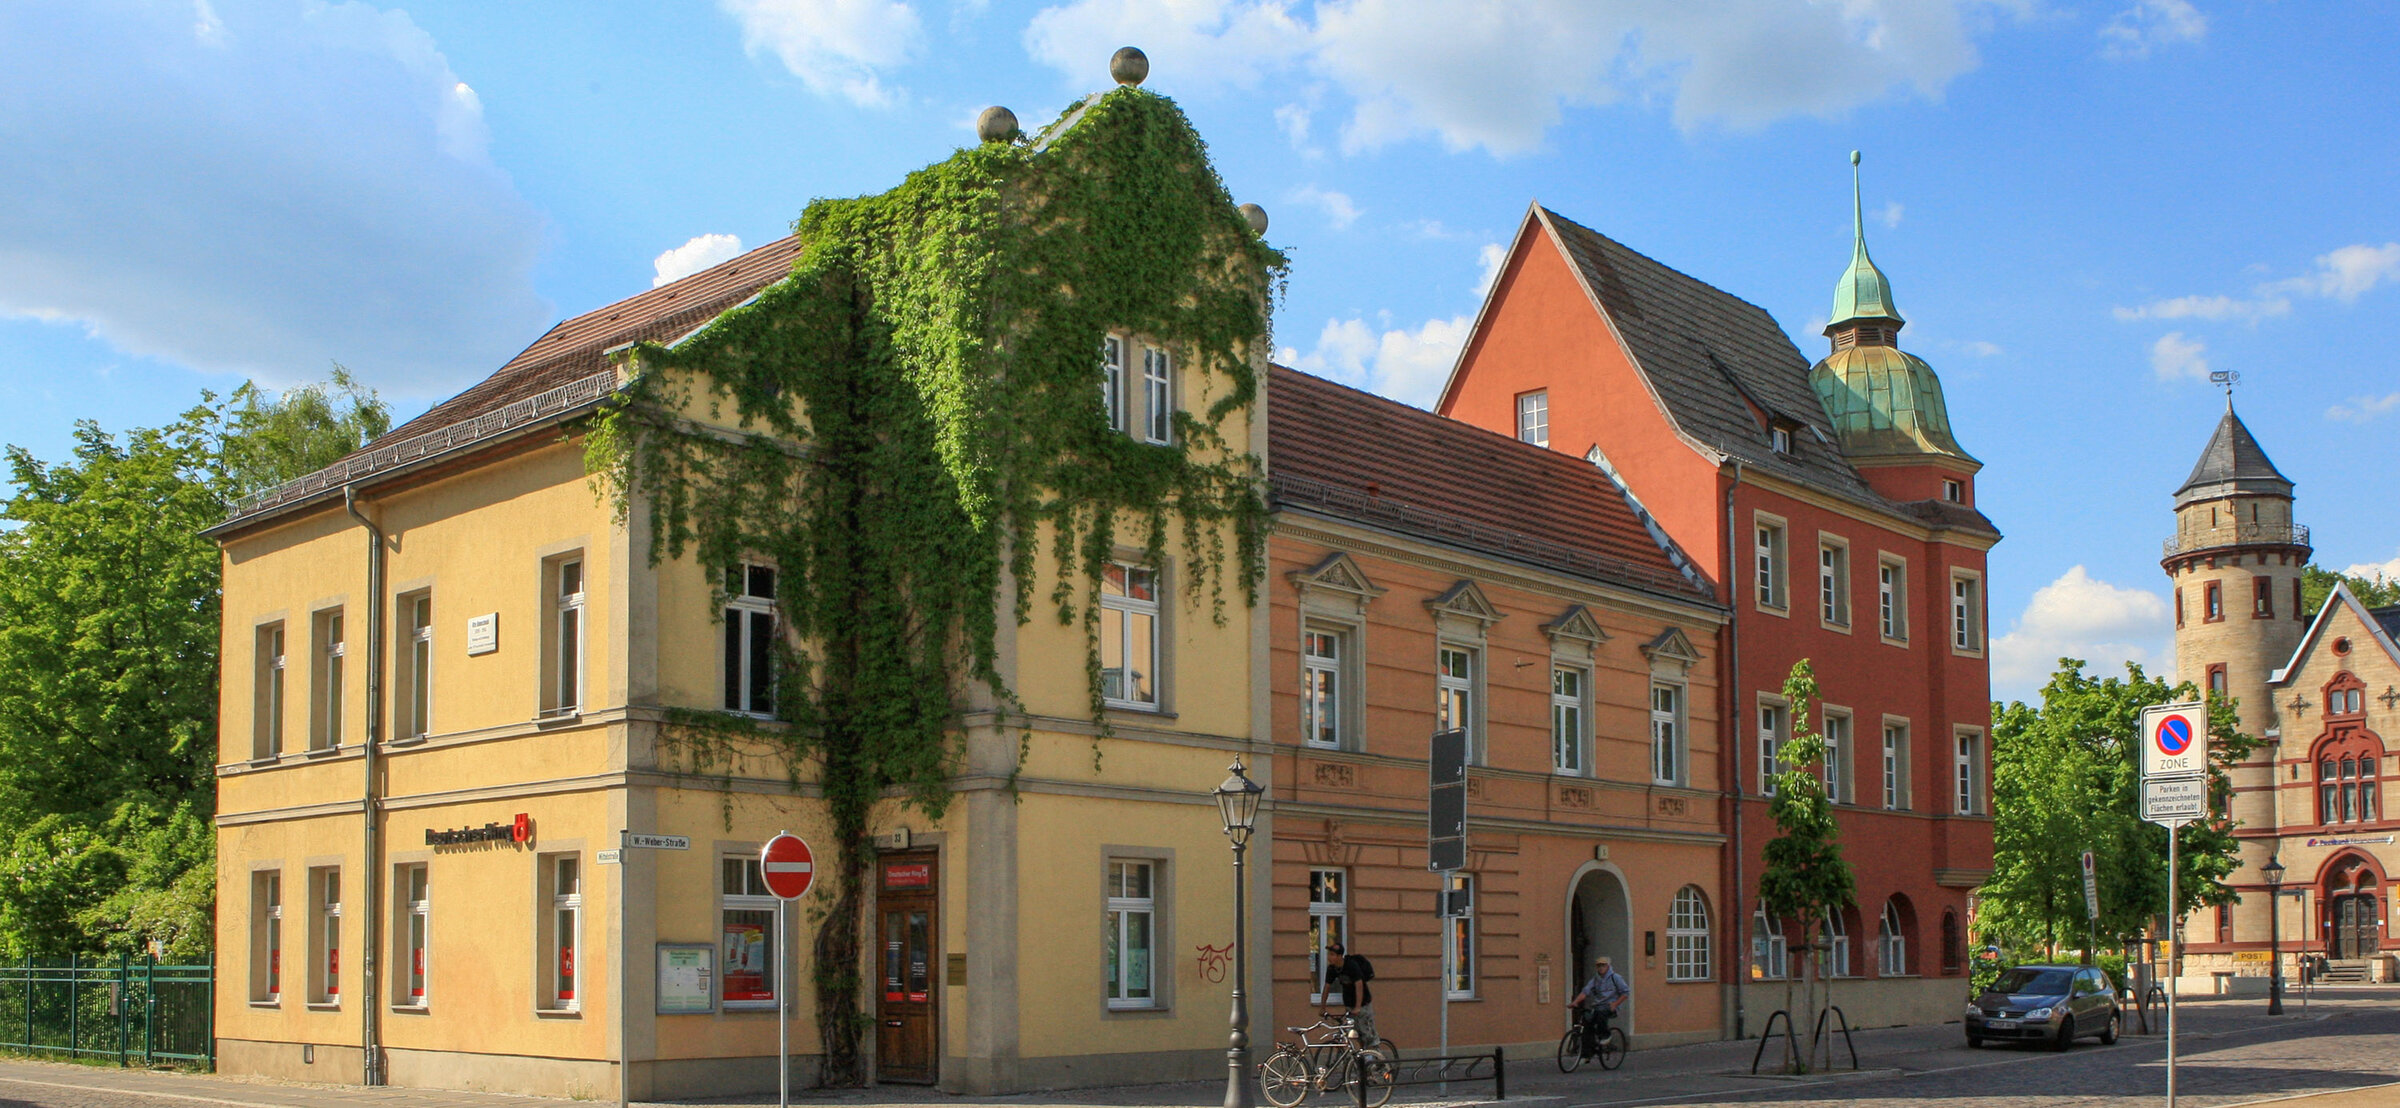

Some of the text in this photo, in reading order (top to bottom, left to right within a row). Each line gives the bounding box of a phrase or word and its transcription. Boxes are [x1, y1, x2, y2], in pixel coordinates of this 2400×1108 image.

[2160, 758, 2188, 769] ZONE
[2148, 794, 2200, 804] gekennzeichneten
[2151, 803, 2198, 813] Flächen erlaubt
[634, 837, 686, 847] W.-Weber-Straße
